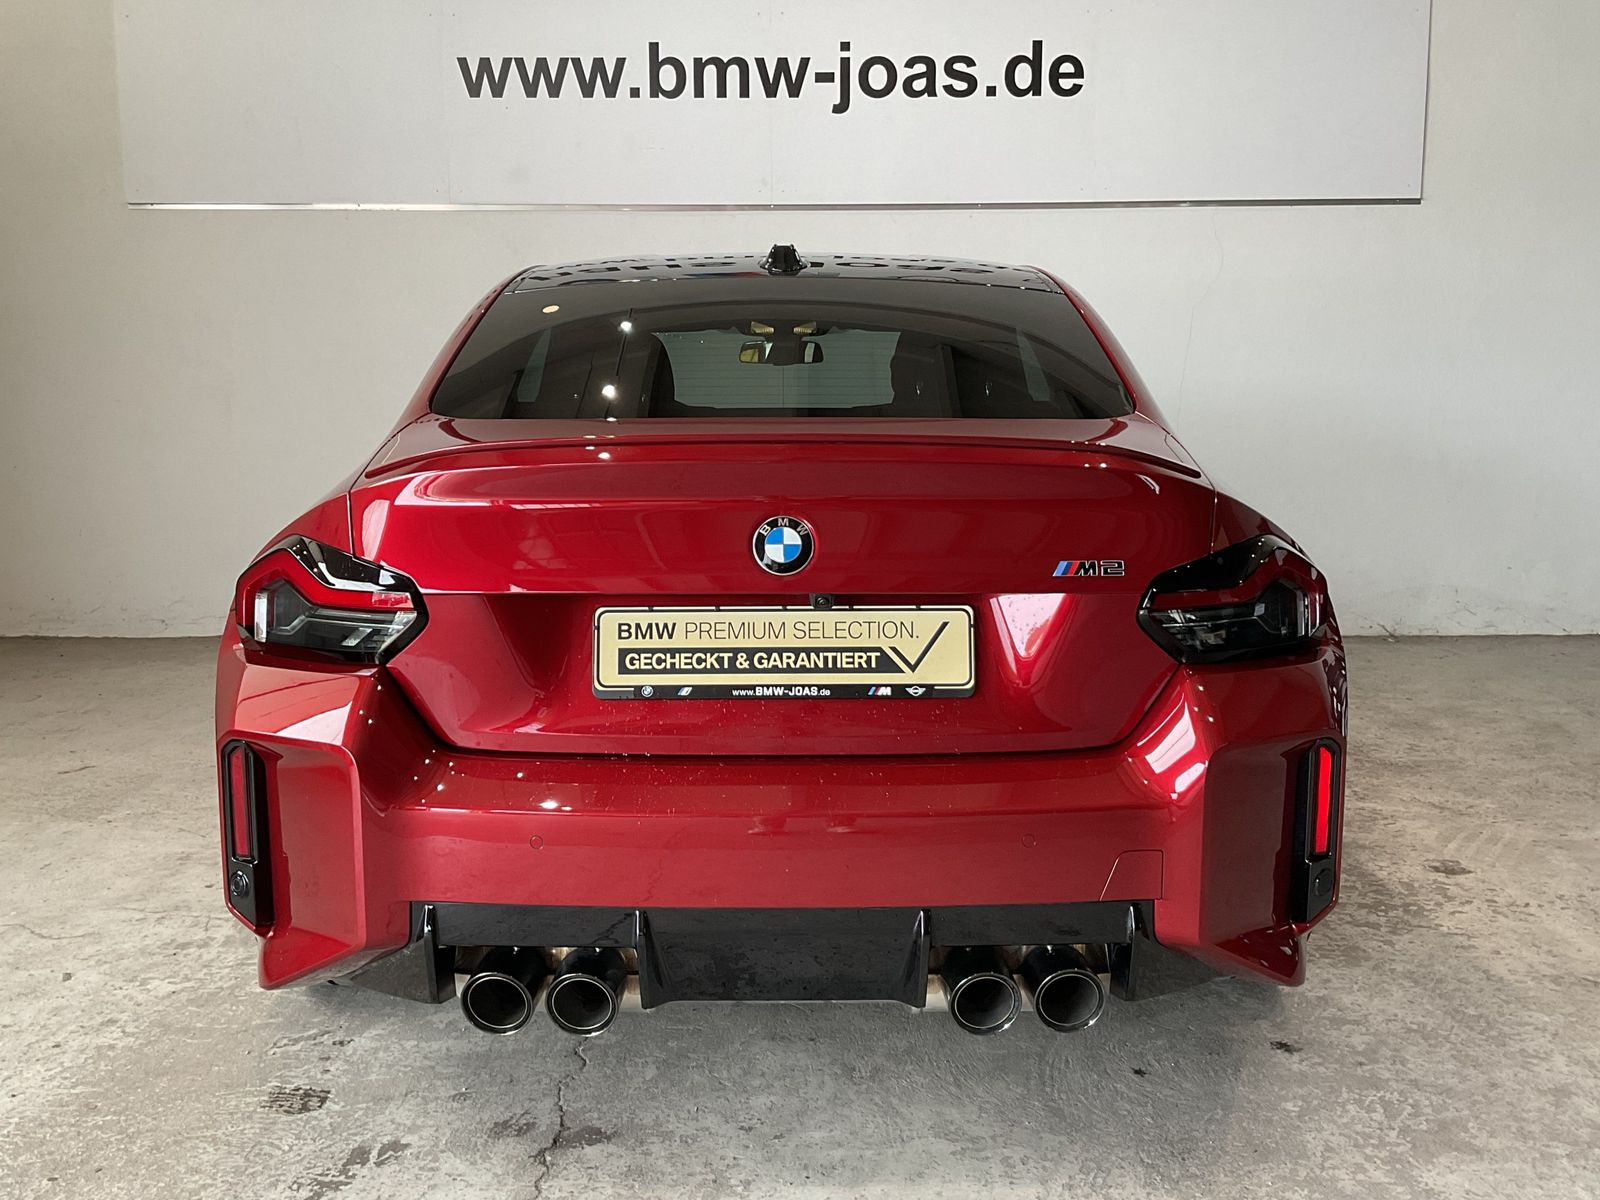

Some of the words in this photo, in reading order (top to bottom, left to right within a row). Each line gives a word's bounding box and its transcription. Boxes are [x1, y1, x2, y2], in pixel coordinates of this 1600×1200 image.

[456, 40, 1086, 115] www.bmw-joas.de
[759, 517, 809, 537] BMW
[617, 622, 677, 640] BMW
[684, 621, 787, 640] PREMIUM
[792, 620, 920, 640] SELECTION.
[624, 652, 733, 670] GECHECKT
[735, 652, 750, 669] &
[753, 652, 881, 669] GARANTIERT
[732, 686, 831, 697] www.BMW-JOAS.de
